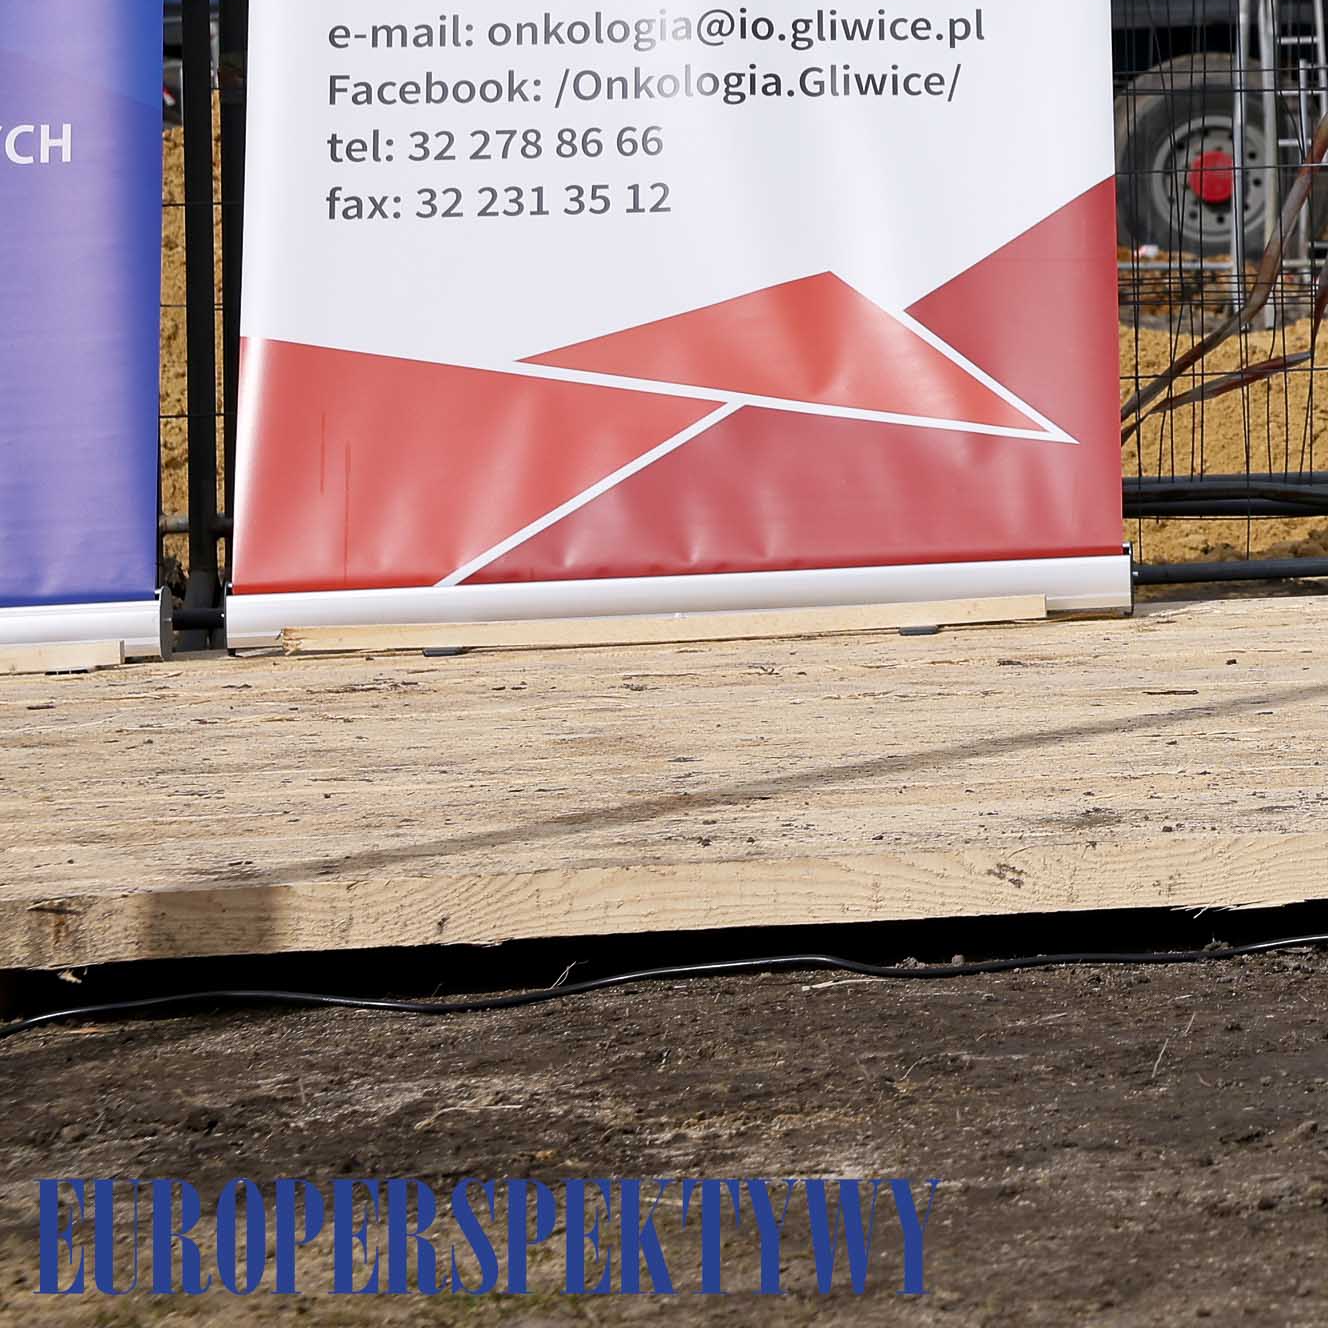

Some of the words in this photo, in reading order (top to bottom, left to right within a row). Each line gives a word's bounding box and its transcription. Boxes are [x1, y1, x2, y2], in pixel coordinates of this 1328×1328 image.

[327, 14, 476, 50] e-mail:
[488, 8, 986, 53] onkologia@io.gliwice.pl
[327, 70, 542, 107] Facebook:
[555, 63, 961, 109] /Onkologia.Gliwice/
[0, 124, 72, 164] CH
[327, 130, 395, 163] tel:
[408, 130, 457, 162] 32
[469, 128, 544, 161] 278
[556, 127, 605, 158] 86
[616, 125, 664, 157] 66
[326, 185, 401, 222] fax:
[415, 186, 464, 218] 32
[476, 185, 550, 217] 231
[563, 184, 612, 216] 35
[625, 181, 672, 213] 12
